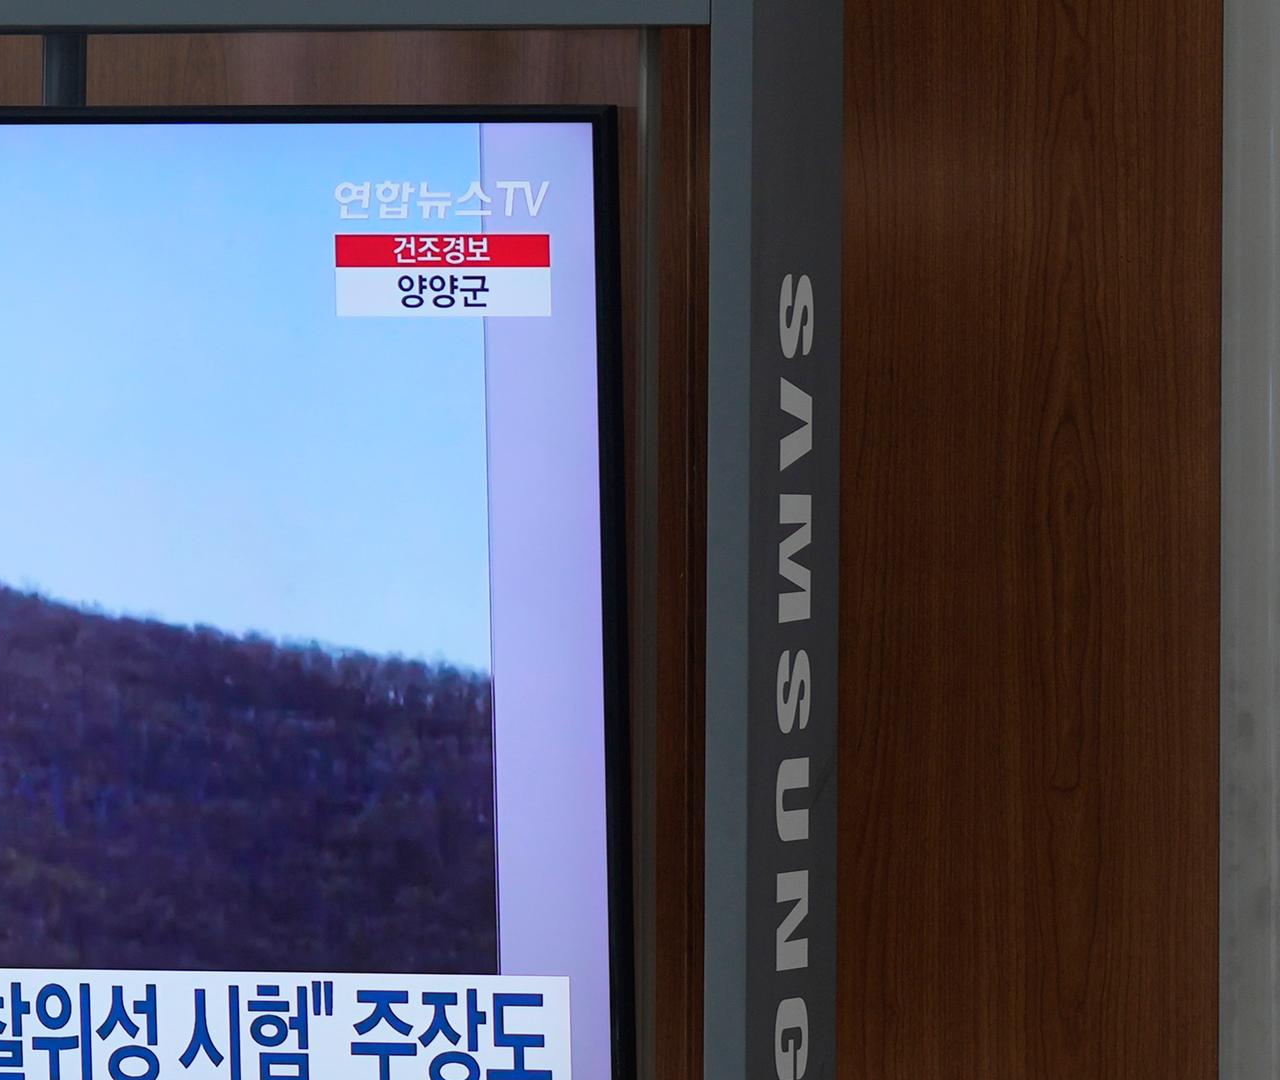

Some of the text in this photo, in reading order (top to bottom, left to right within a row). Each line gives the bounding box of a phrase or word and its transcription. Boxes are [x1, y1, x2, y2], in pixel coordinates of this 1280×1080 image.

[333, 180, 551, 220] 연합뉴스TV
[393, 236, 491, 265] 건조경보
[397, 274, 490, 309] 양양군
